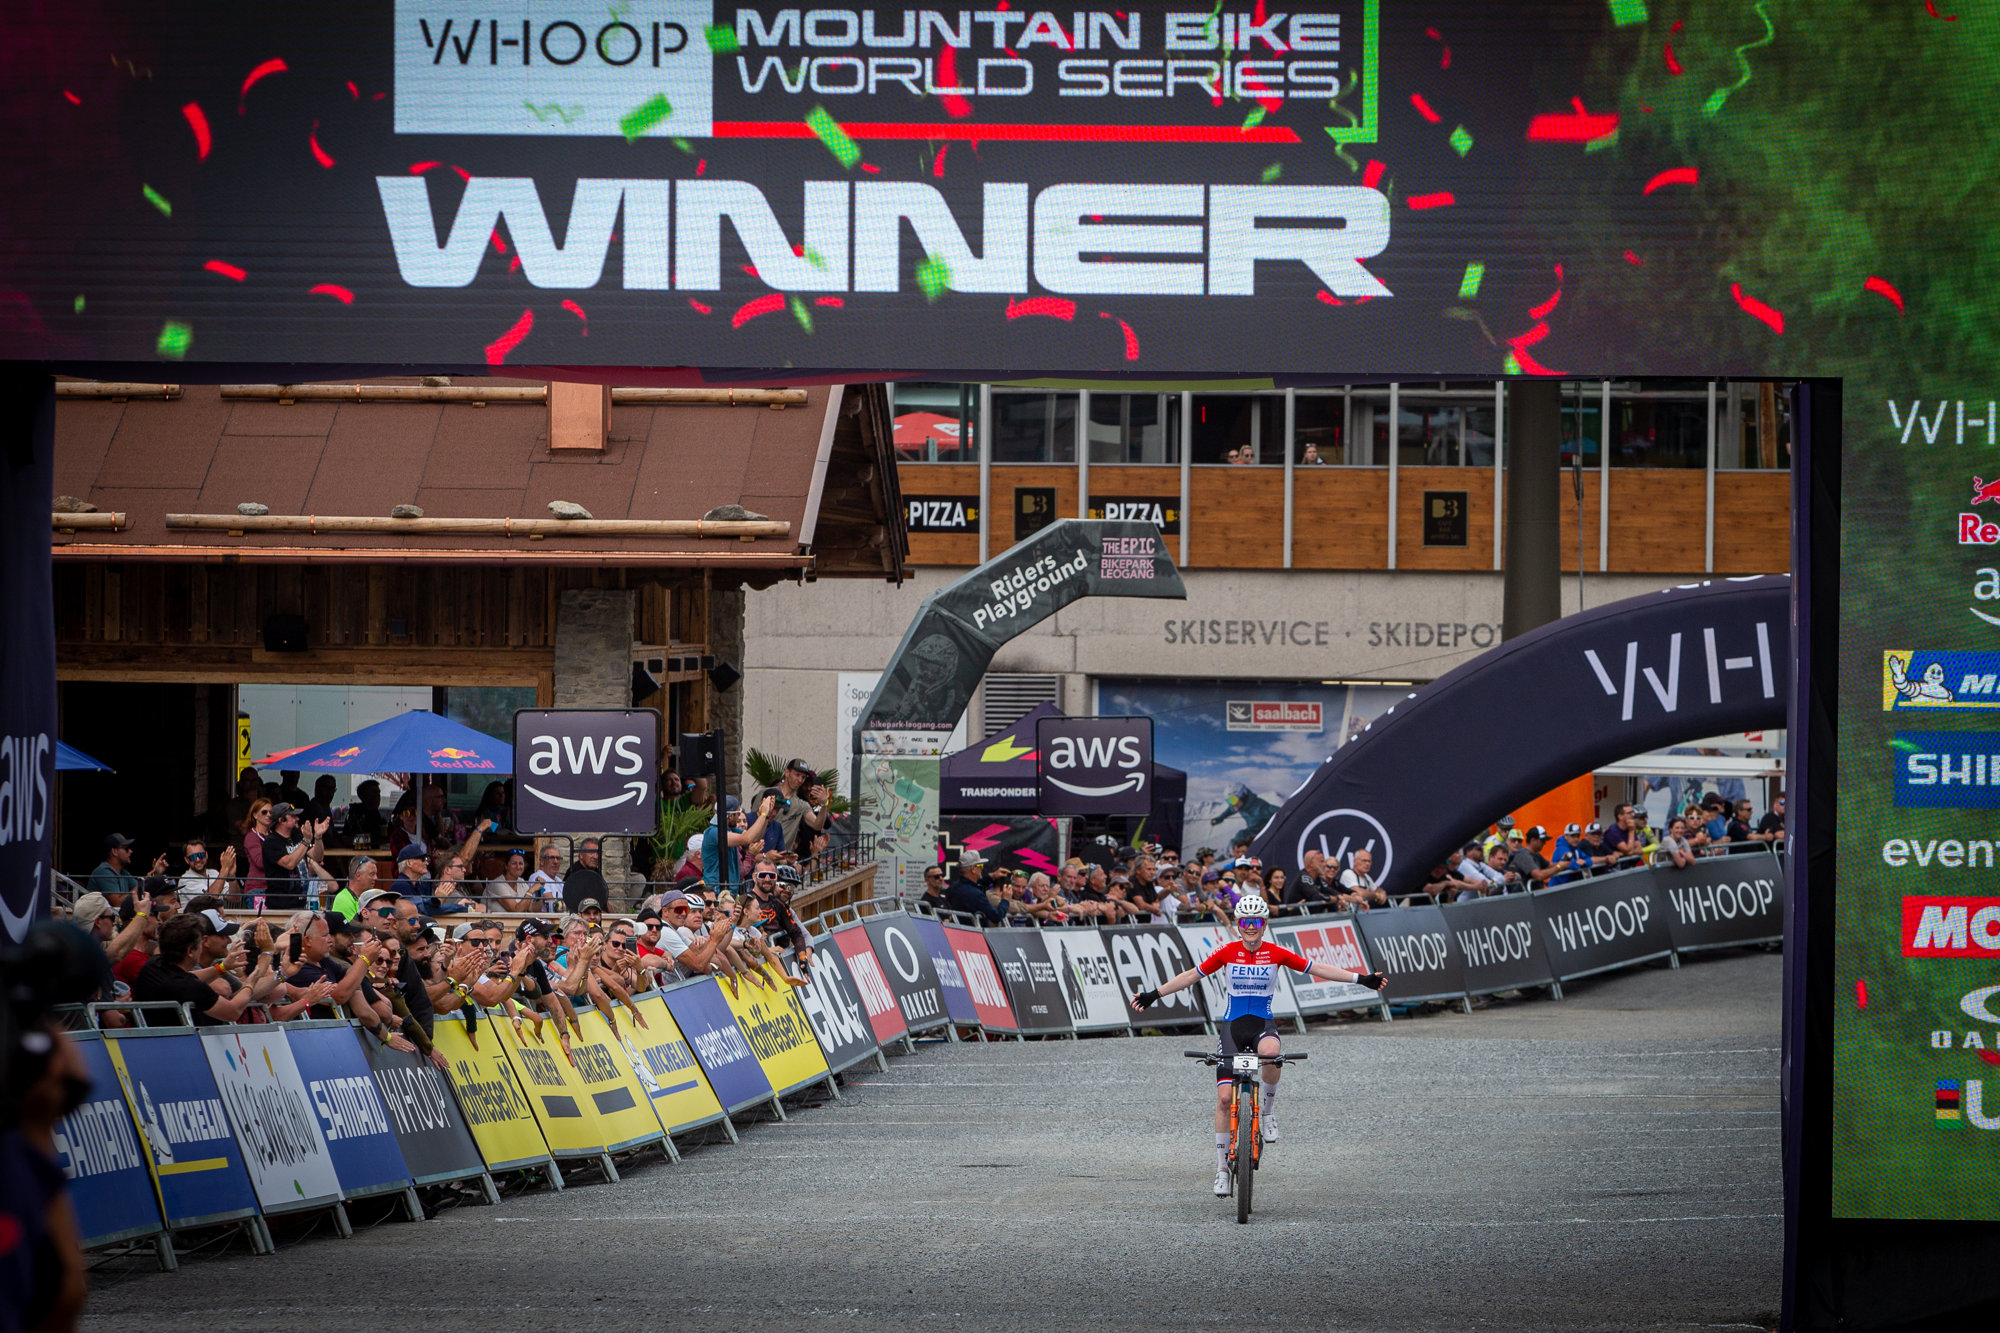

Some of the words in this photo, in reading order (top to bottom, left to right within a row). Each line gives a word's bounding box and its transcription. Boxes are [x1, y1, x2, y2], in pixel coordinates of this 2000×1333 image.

[419, 19, 689, 68] WHOOP
[736, 8, 1141, 50] MOUNTAIN
[1165, 13, 1340, 52] BIKE
[736, 55, 1034, 96] WORLD
[1057, 59, 1340, 99] SERIES
[376, 176, 1393, 297] WINNER
[909, 501, 967, 527] PIZZA
[1105, 502, 1165, 528] PIZZA
[1101, 559, 1154, 569] BIKEPARK
[1102, 542, 1120, 554] THE
[1121, 537, 1156, 554] EPIC
[972, 549, 1088, 630] Playground
[990, 553, 1057, 600] Riders
[1101, 569, 1155, 579] LEOGANG
[1164, 620, 1330, 647] SKISERVICE
[870, 721, 953, 730] bikepark-leogang.com
[1256, 702, 1316, 720] saalbach
[430, 760, 463, 769] Red
[464, 760, 496, 769] Bull
[529, 735, 643, 776] aws
[1050, 736, 1141, 769] aws
[0, 733, 49, 846] aws
[960, 787, 1036, 797] TRANSPONDER
[1882, 838, 2000, 868] even
[1669, 879, 1774, 925] WHOOP
[1456, 921, 1532, 968] WHOOP
[1549, 895, 1650, 953] WHOOP
[1305, 928, 1362, 969] saalbach
[1374, 933, 1447, 975] WHOOP
[847, 951, 895, 1017] MOTUL
[957, 950, 1007, 1008] MOTUL
[1077, 956, 1114, 986] PEAST
[1232, 966, 1269, 976] FENIX
[901, 988, 940, 1021] OAKLEY
[694, 1023, 750, 1070] events.com
[737, 1002, 803, 1061] Raiffeisen
[642, 1039, 696, 1076] MICHELIN
[1242, 1060, 1250, 1068] 3
[310, 1076, 388, 1141] SHIMANO
[374, 1066, 450, 1134] WHOOP
[53, 1099, 140, 1179] SHIMANO
[159, 1099, 231, 1143] MICHELIN
